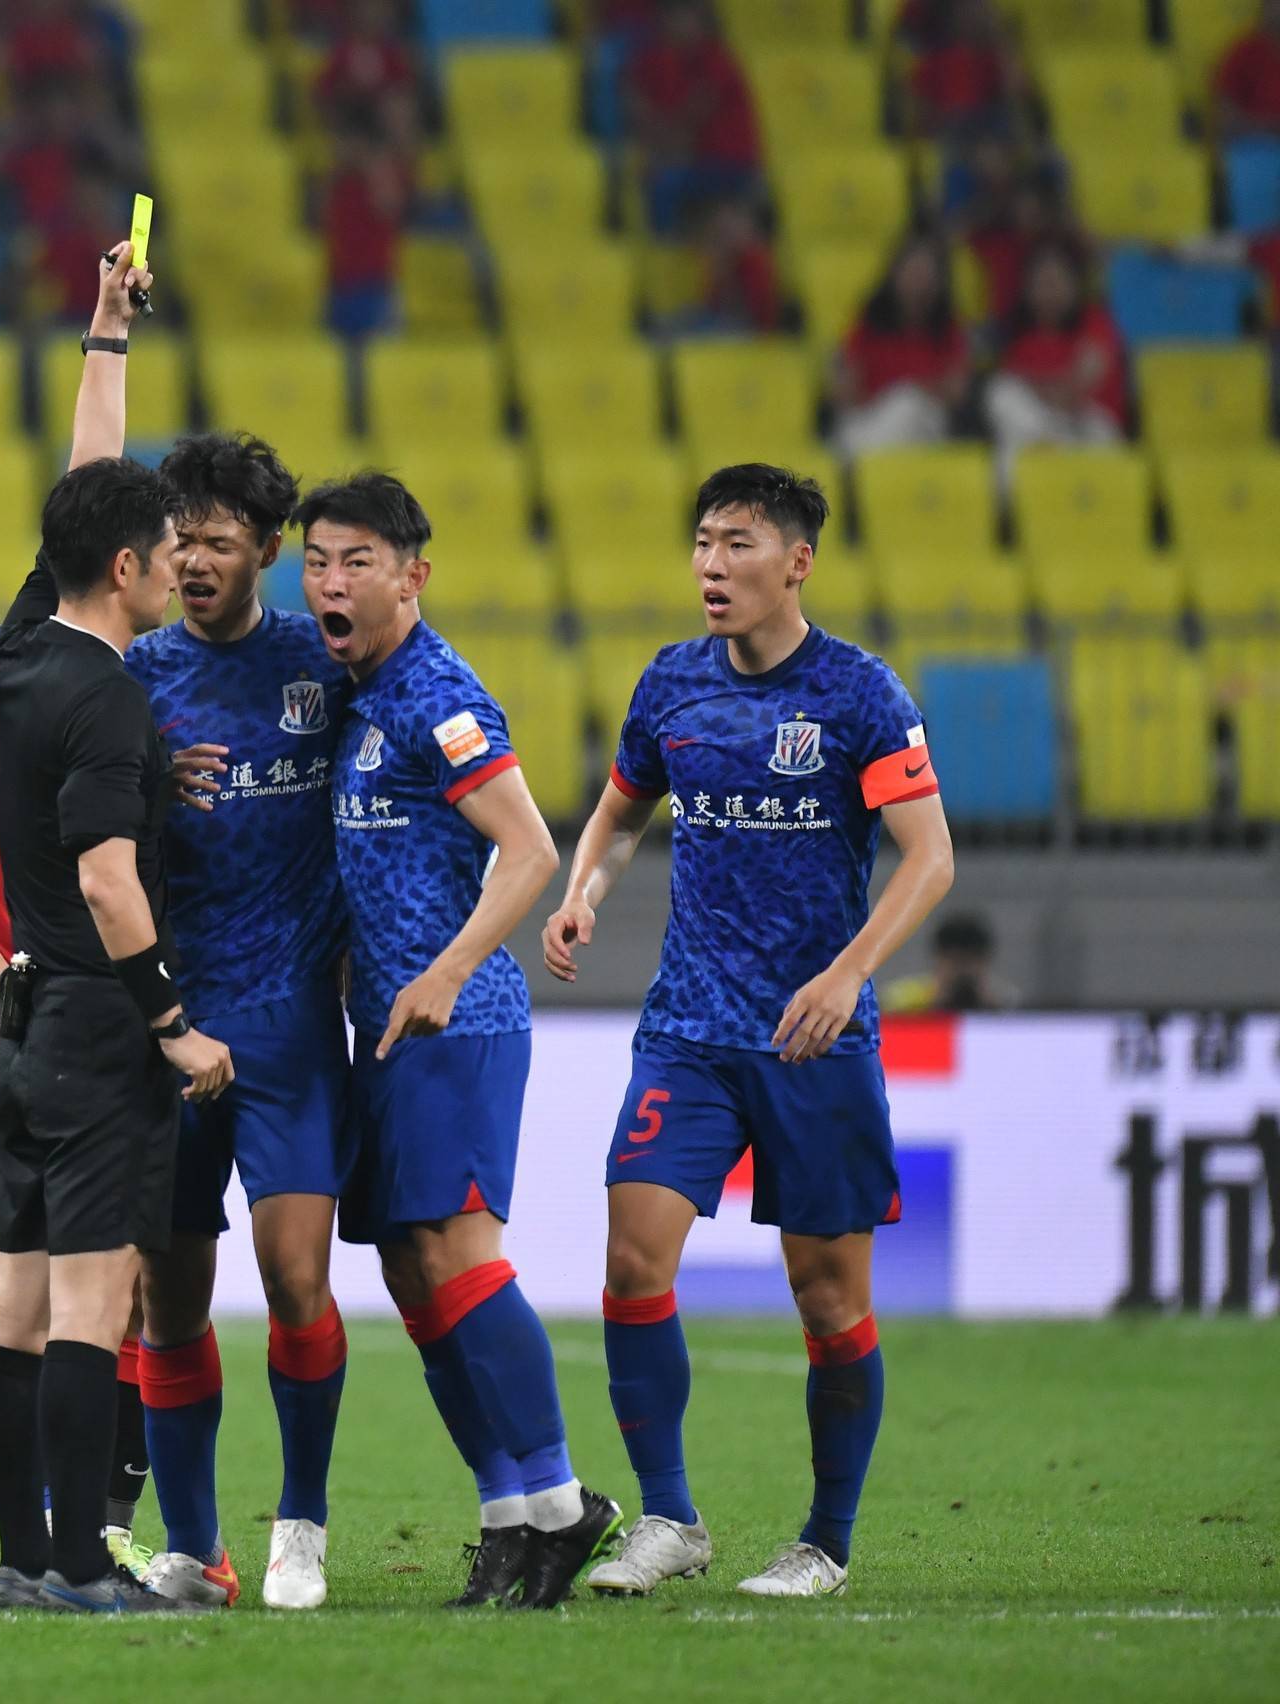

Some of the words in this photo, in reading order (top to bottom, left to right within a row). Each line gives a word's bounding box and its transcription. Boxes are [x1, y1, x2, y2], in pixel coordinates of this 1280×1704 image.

[220, 791, 237, 801] OF
[693, 790, 820, 820] 交通銀行
[687, 816, 711, 827] BANK
[715, 819, 731, 828] OF
[735, 819, 832, 831] COMMUNICATIONS
[627, 1088, 671, 1143] 5
